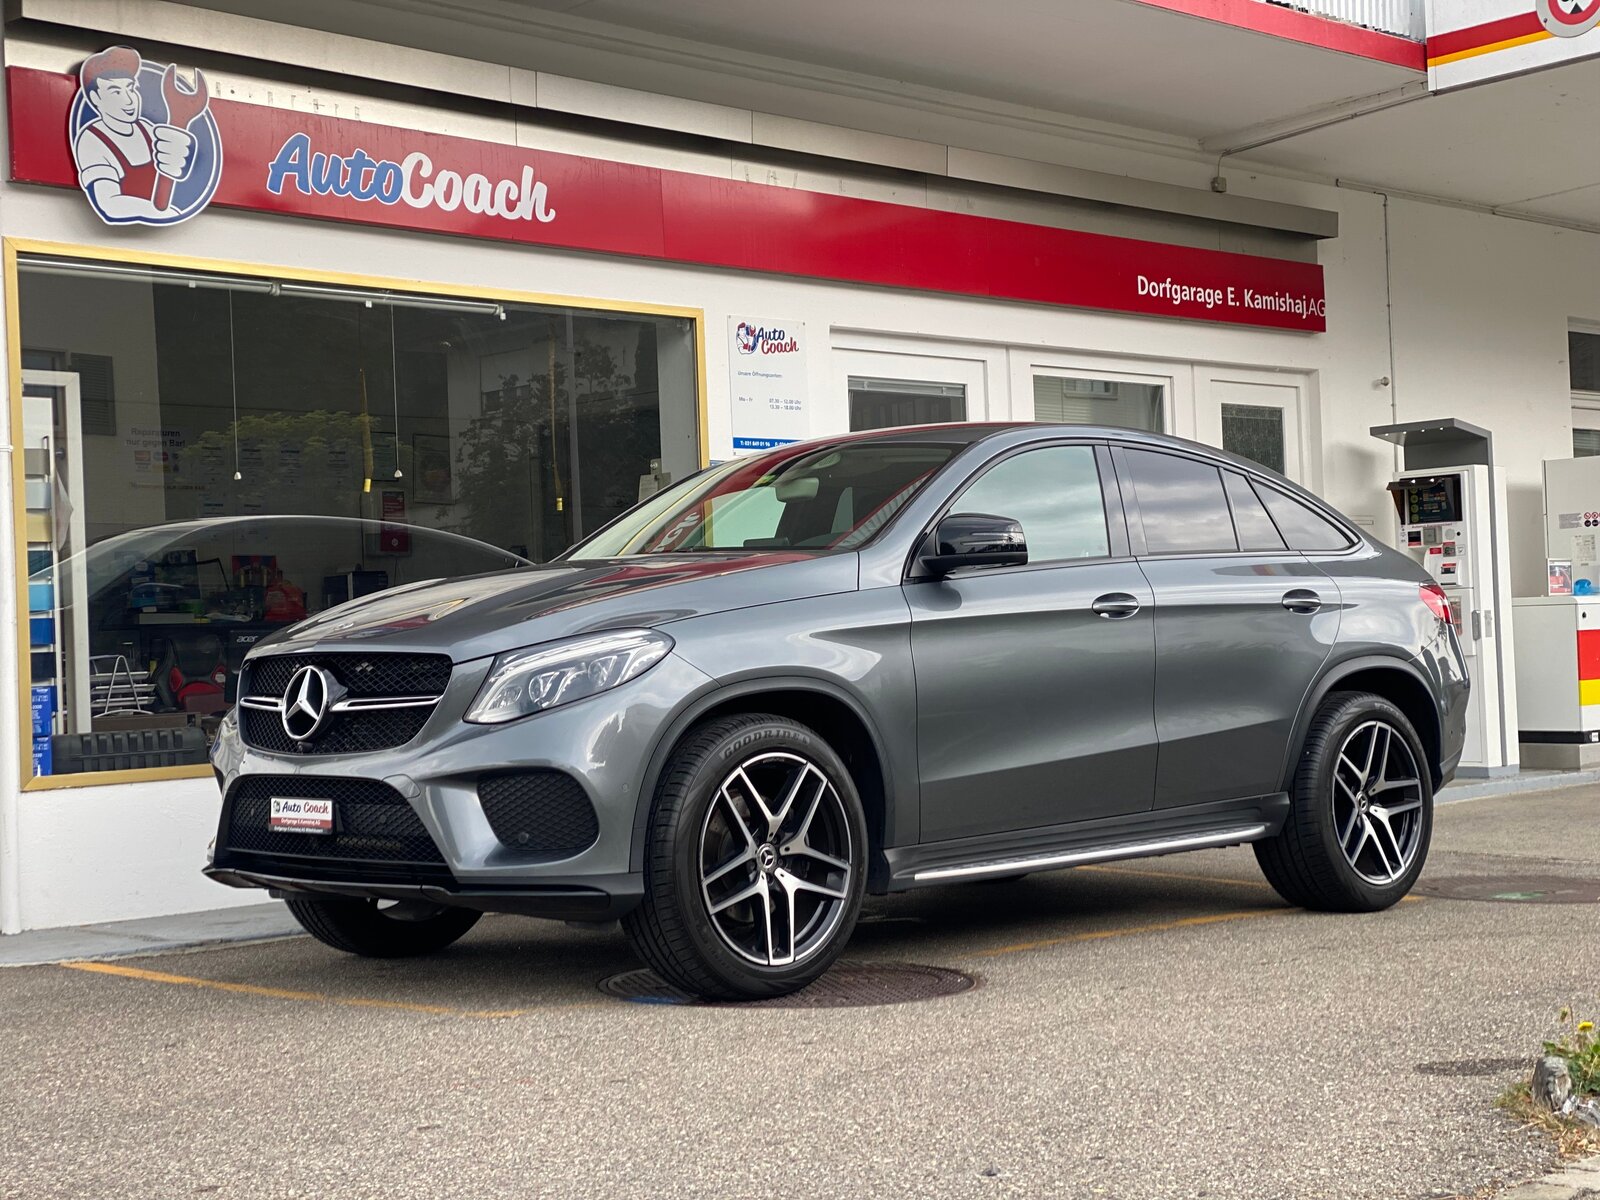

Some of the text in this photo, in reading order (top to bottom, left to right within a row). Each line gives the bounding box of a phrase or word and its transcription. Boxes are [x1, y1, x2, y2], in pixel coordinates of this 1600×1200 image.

[1137, 275, 1223, 308] Dorfgarage
[1227, 287, 1239, 307] E.
[1244, 289, 1307, 319] Kamishaj
[756, 326, 785, 343] Auto
[761, 336, 800, 355] Coach
[236, 635, 258, 643] acer
[282, 801, 329, 814] Auto Coach
